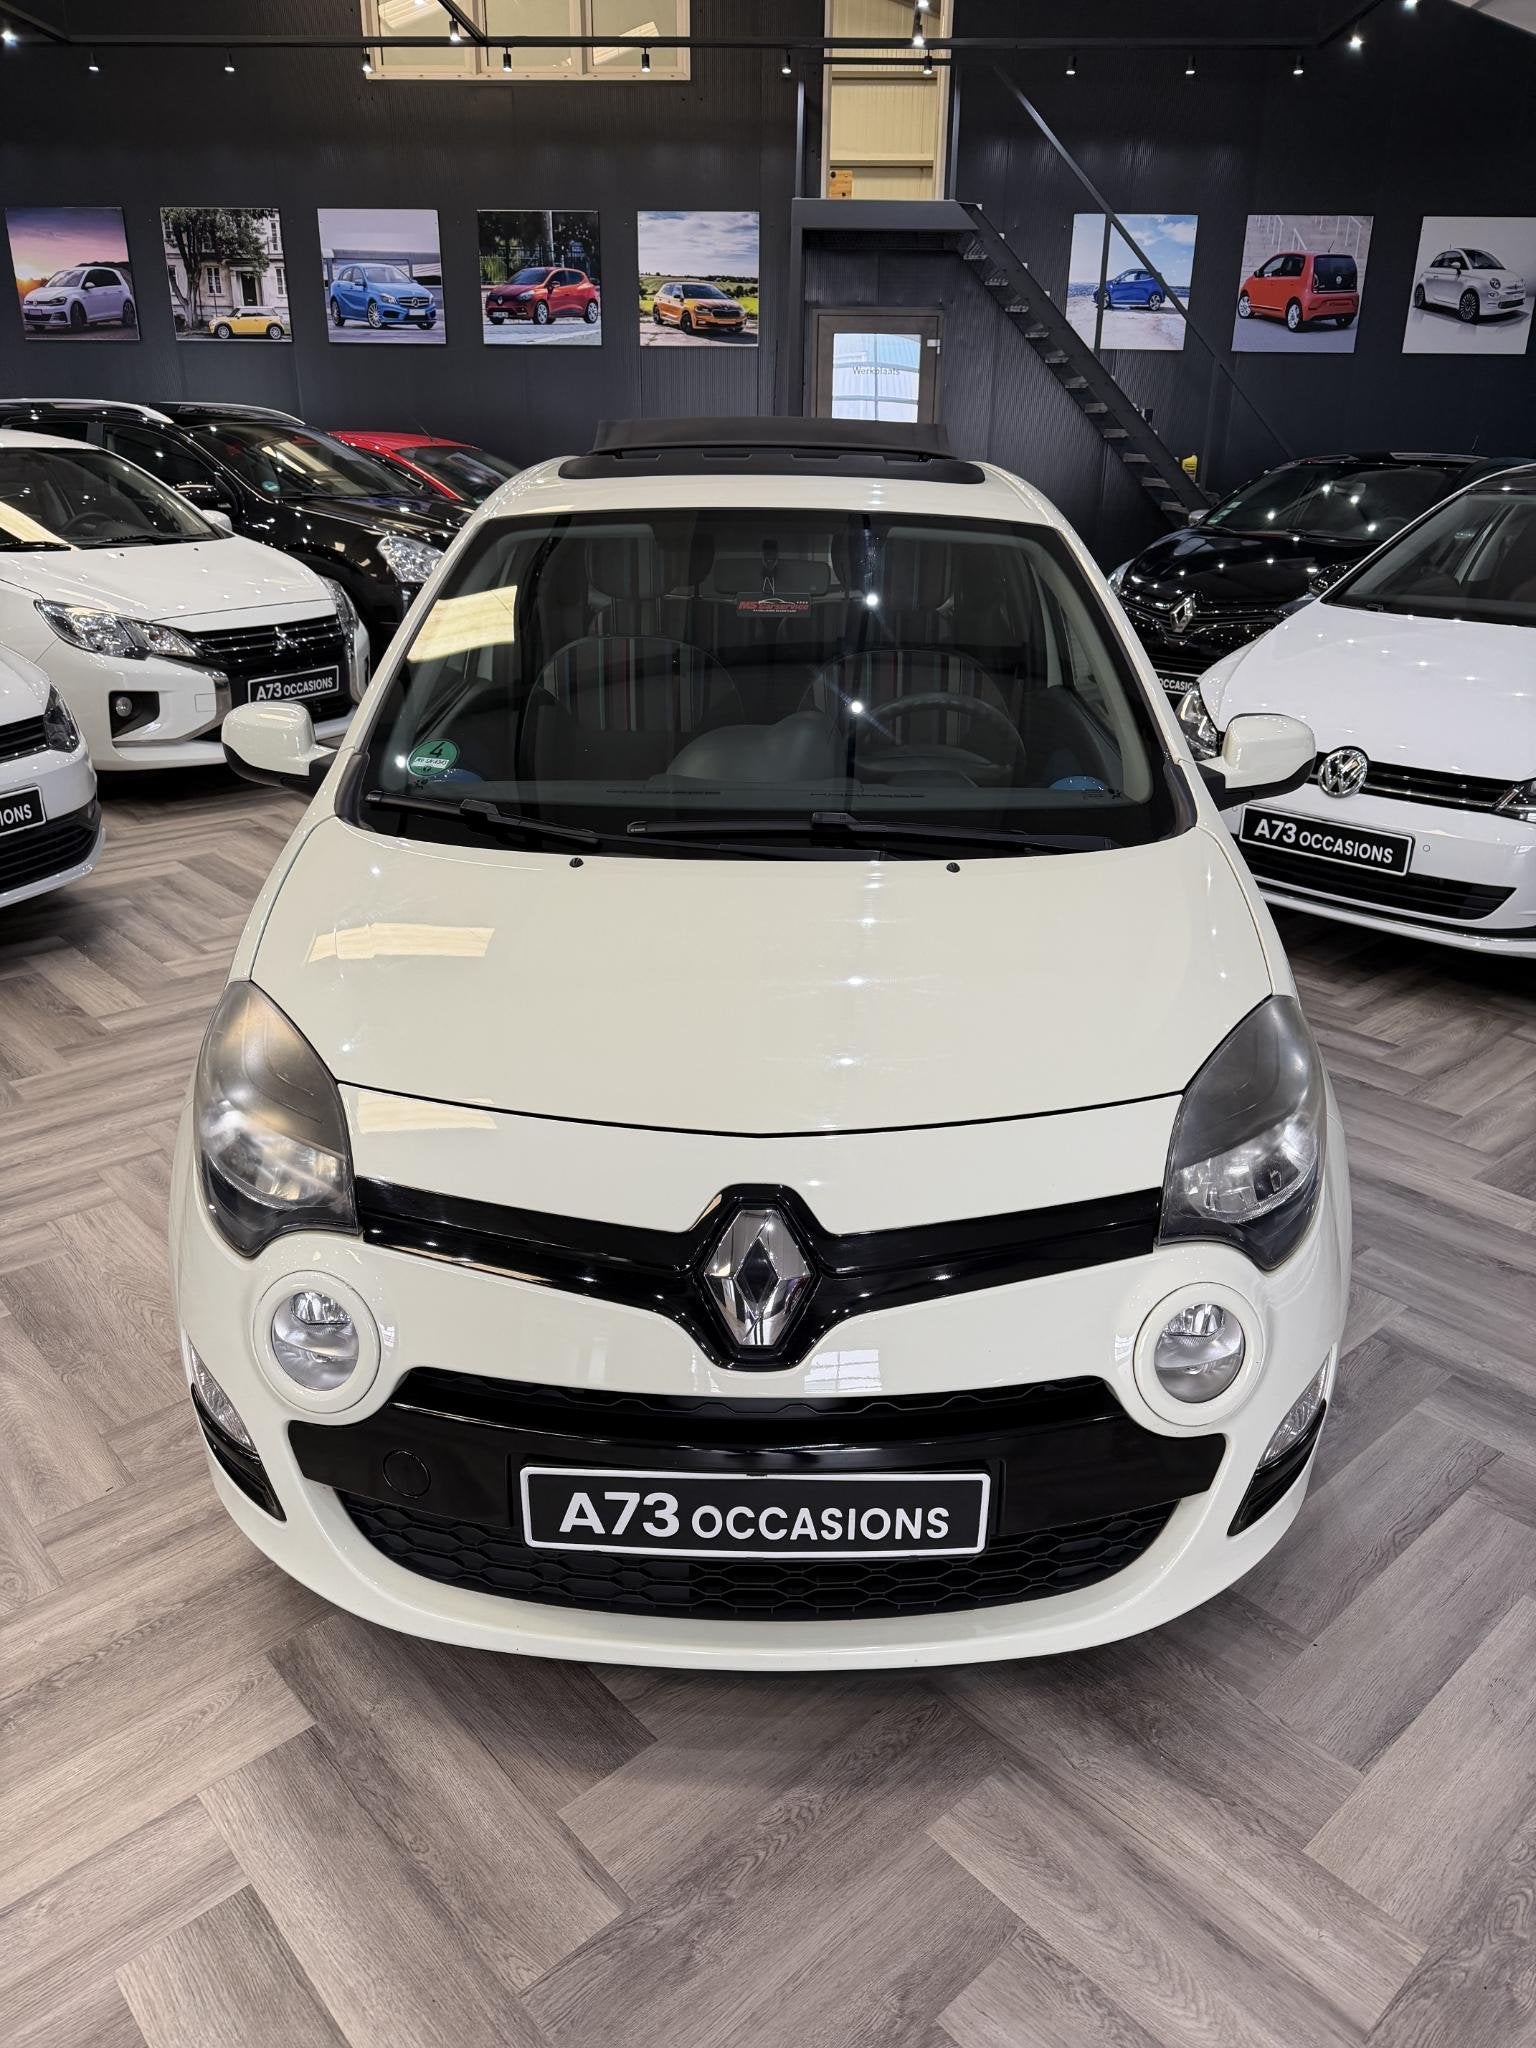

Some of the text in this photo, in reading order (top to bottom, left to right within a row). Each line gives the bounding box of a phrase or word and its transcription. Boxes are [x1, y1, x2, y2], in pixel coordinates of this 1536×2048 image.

[852, 364, 900, 376] Werkplaats
[256, 677, 333, 700] A73 OCCASIONS
[430, 742, 446, 758] 4
[1254, 818, 1393, 863] A73 OCCASIONS
[559, 1491, 949, 1541] A73 OCCASIONS
